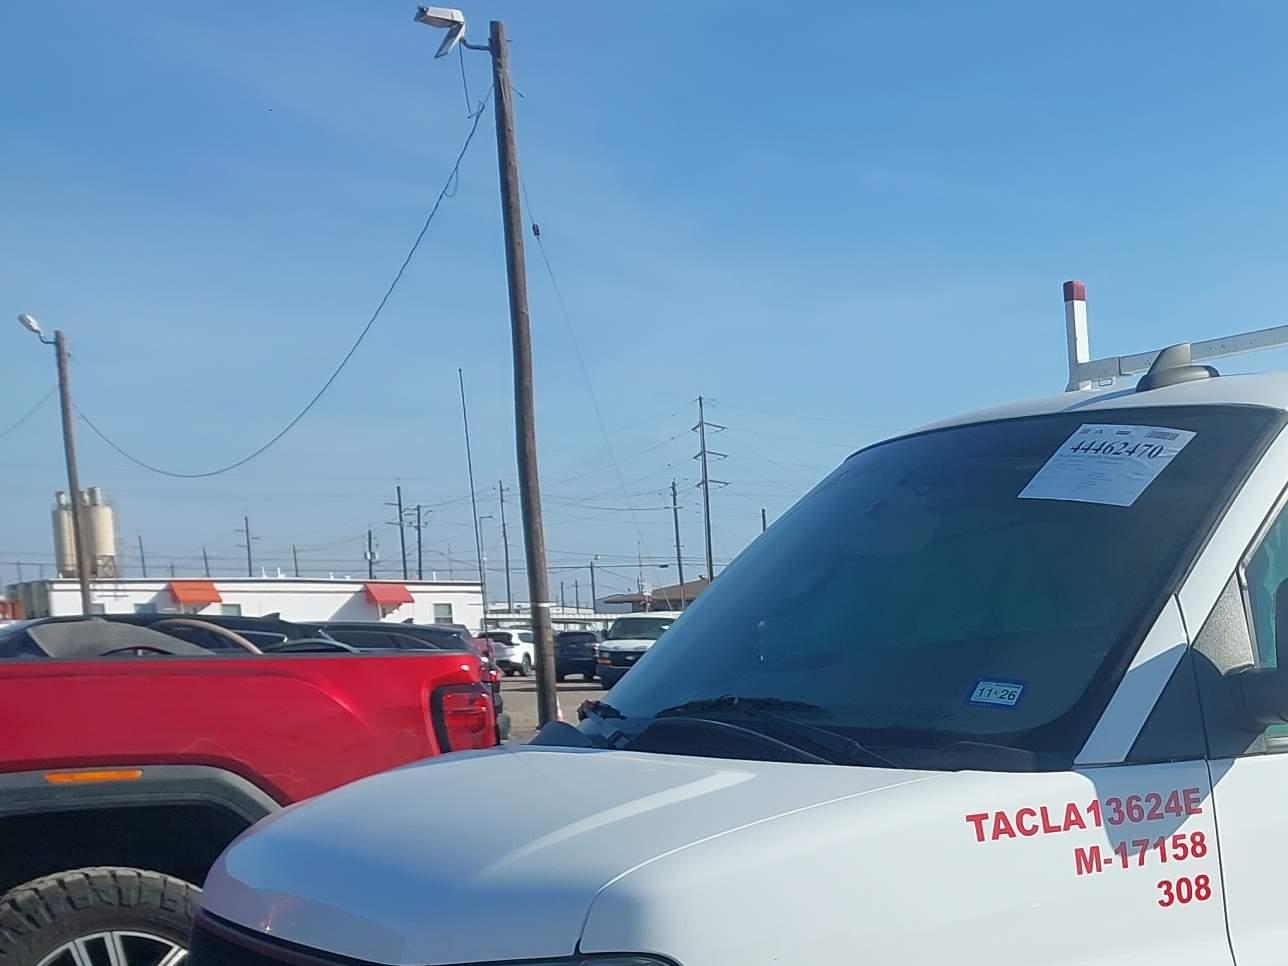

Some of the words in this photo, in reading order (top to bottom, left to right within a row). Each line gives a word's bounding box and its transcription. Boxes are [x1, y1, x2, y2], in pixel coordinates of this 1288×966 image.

[1071, 440, 1164, 459] 44462470
[966, 787, 1203, 842] TACLA13624E
[1074, 831, 1208, 875] M-17158
[1157, 874, 1212, 907] 308
